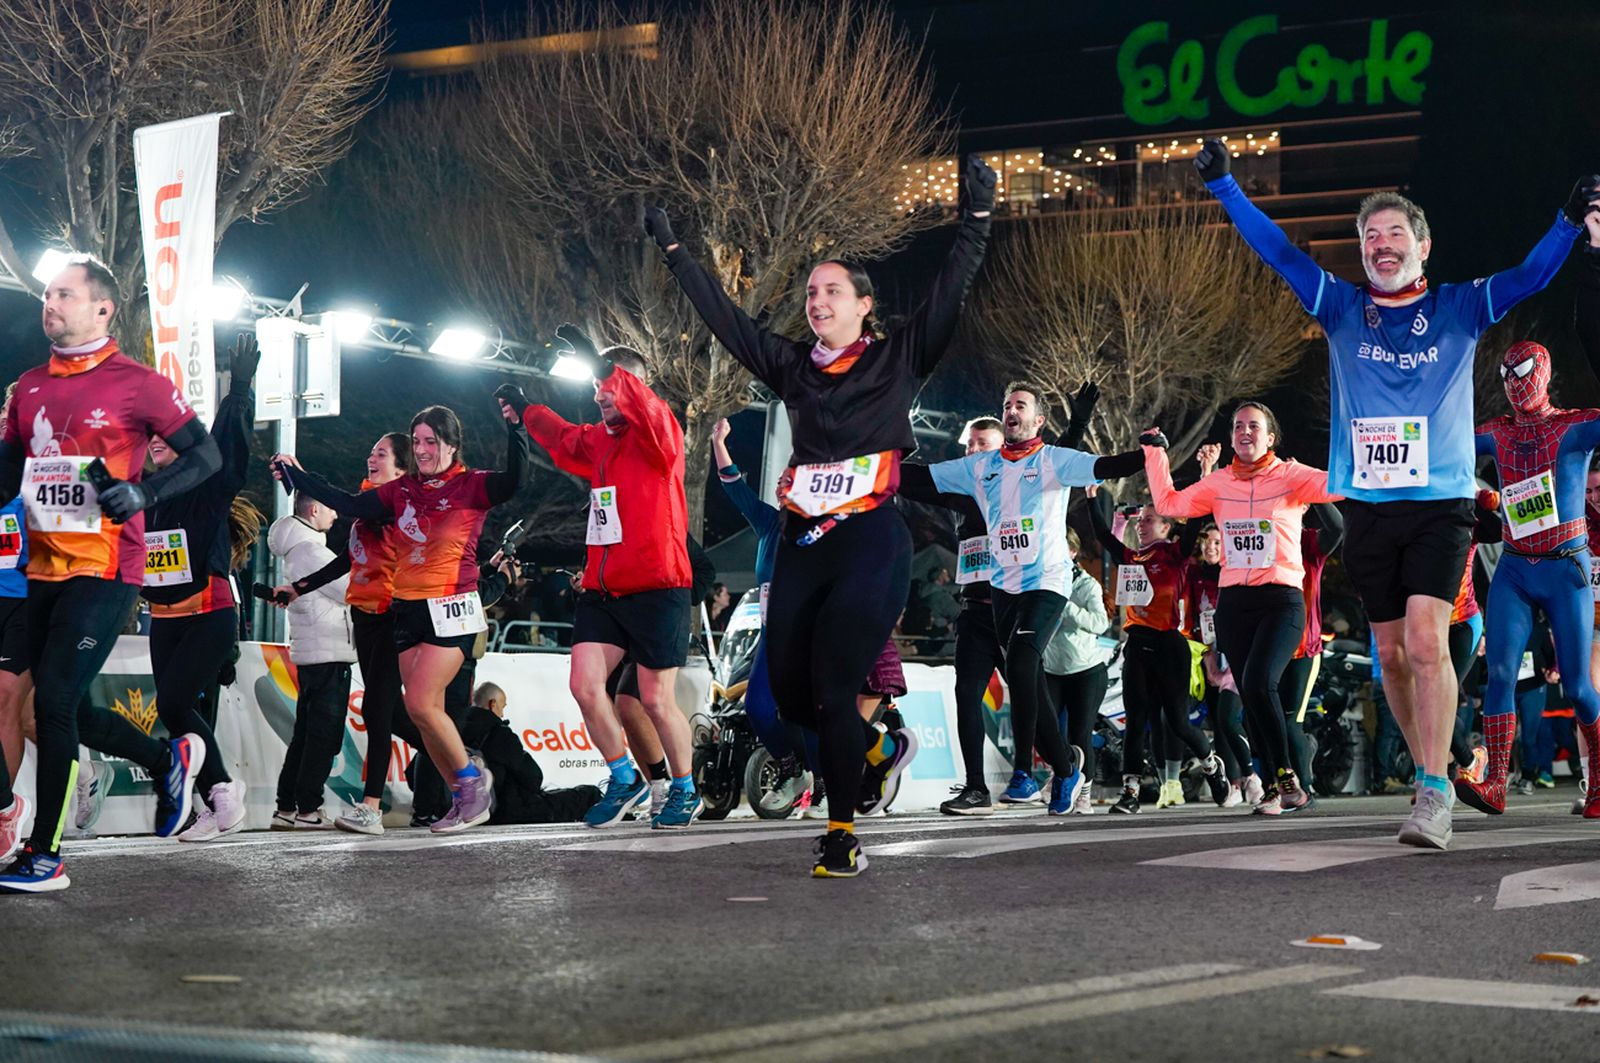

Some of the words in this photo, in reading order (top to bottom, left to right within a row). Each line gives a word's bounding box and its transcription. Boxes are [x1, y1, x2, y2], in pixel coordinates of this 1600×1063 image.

[1117, 21, 1209, 125] El
[1216, 14, 1433, 117] Corte
[1364, 425, 1386, 433] NOCHE
[1387, 425, 1397, 433] DE
[1358, 434, 1371, 443] SAN
[1365, 443, 1409, 465] 7407
[62, 464, 72, 472] DE
[31, 475, 45, 483] SAN
[809, 472, 855, 496] 5191
[36, 483, 85, 506] 4158
[1516, 491, 1553, 518] 8409
[1000, 533, 1029, 550] 6410
[1233, 535, 1265, 551] 6413
[146, 549, 179, 568] 3211
[1125, 579, 1148, 592] 6387
[442, 600, 475, 619] 7018
[559, 757, 588, 769] obras
